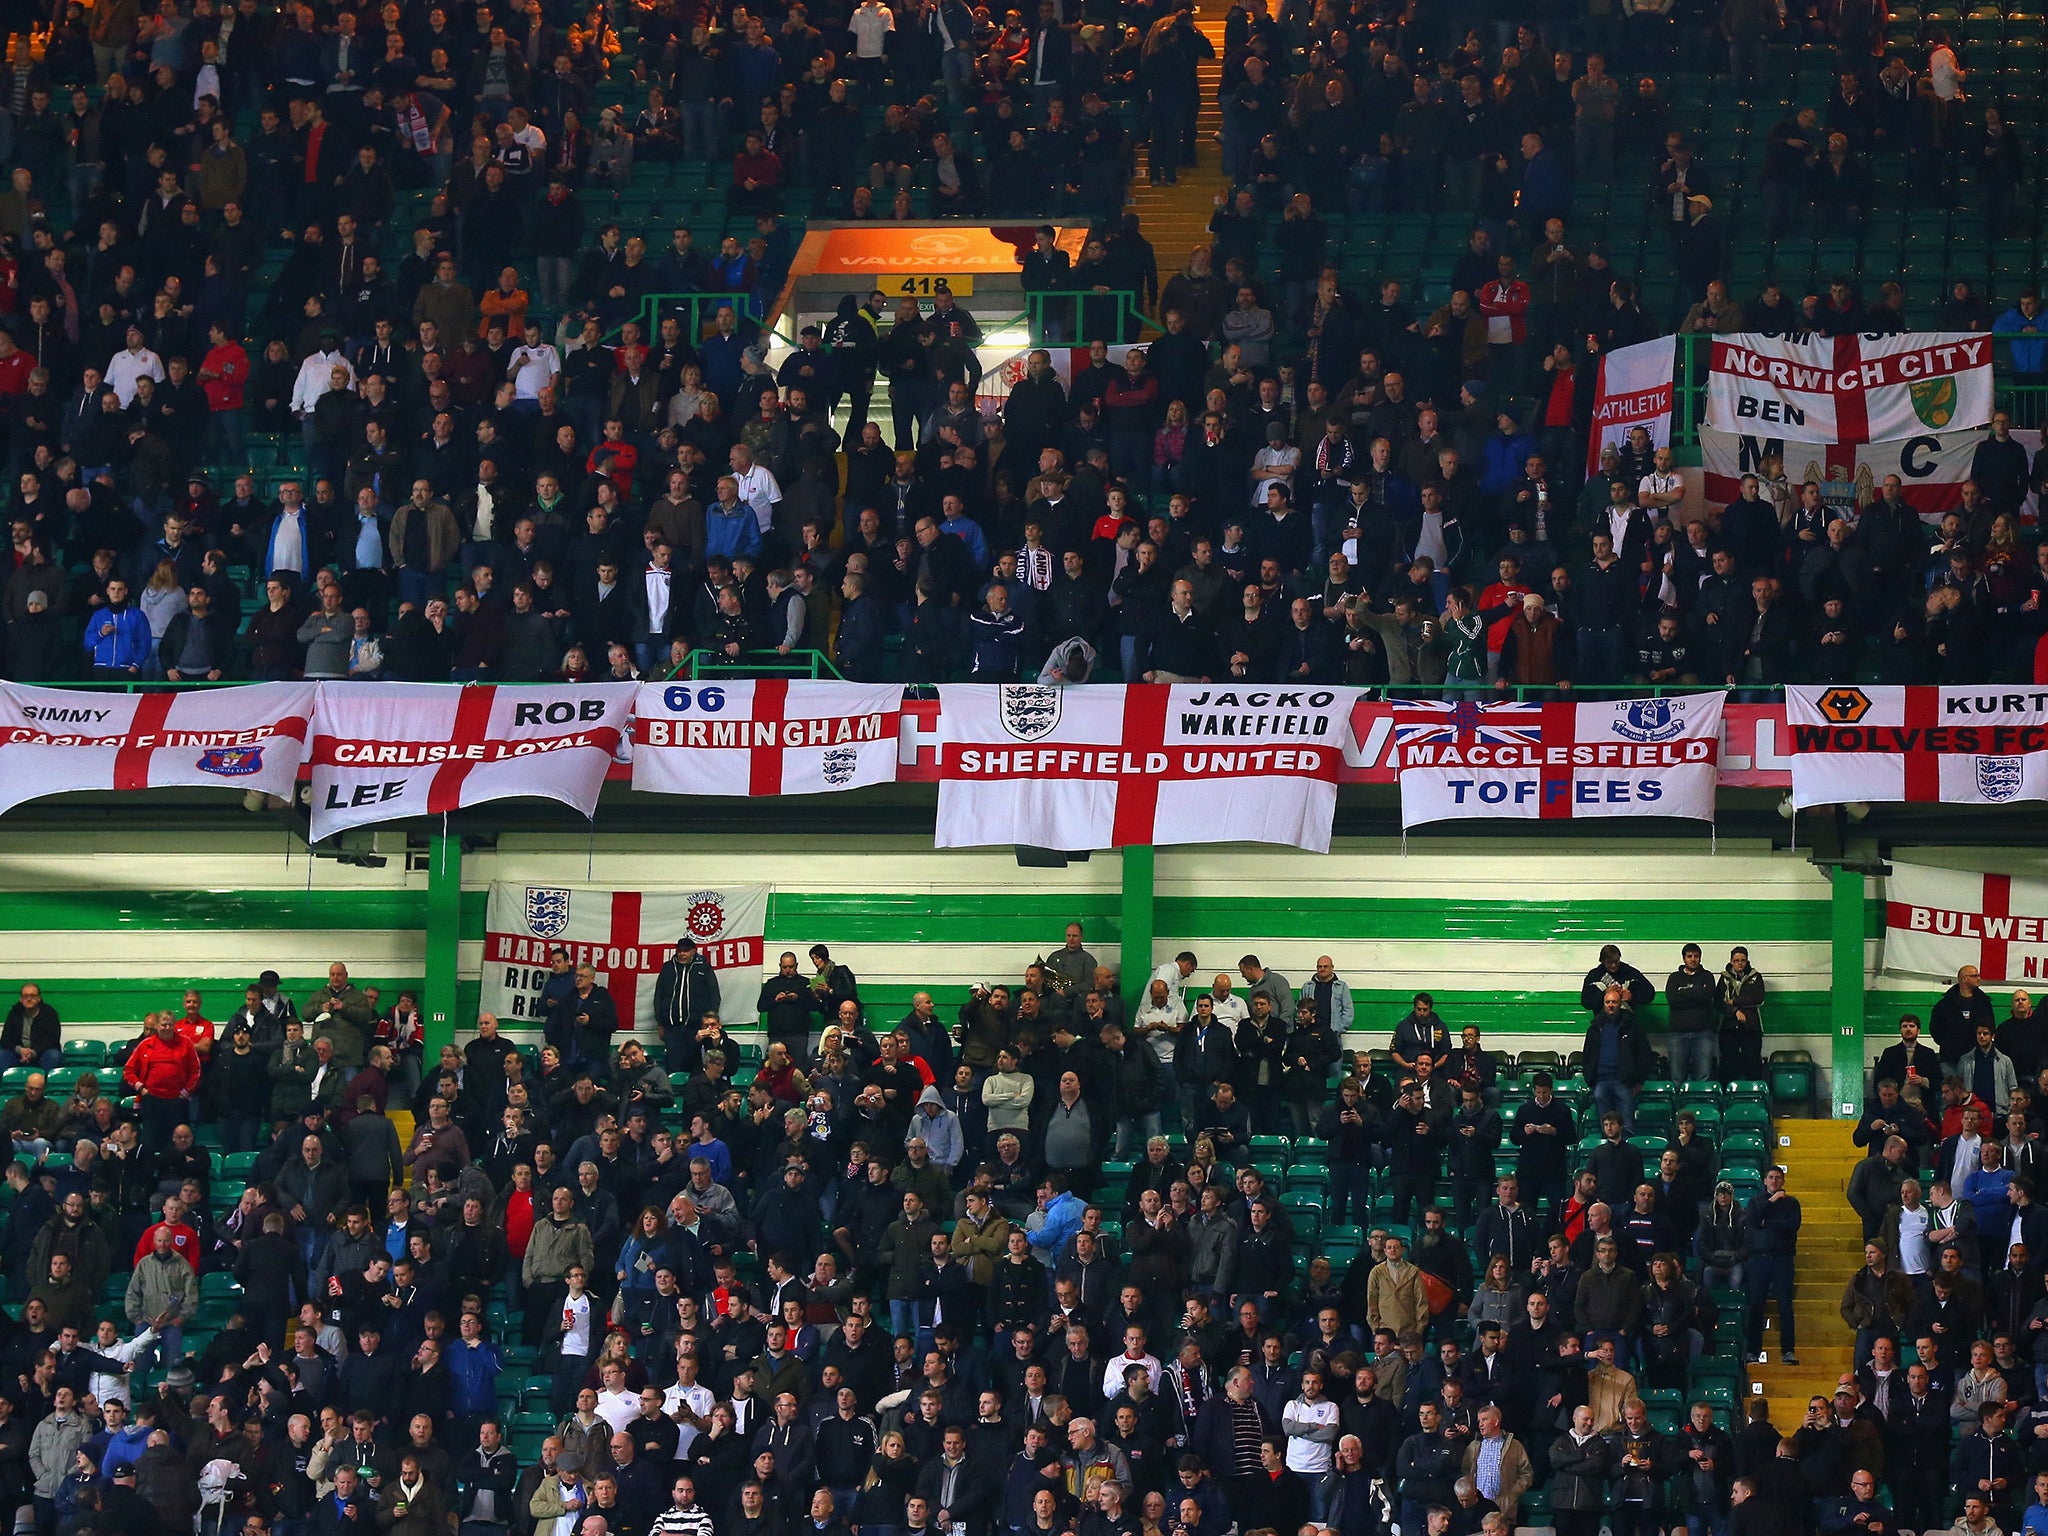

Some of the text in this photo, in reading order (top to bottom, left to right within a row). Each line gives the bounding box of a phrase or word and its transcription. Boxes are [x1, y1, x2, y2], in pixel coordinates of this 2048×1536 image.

[901, 277, 948, 294] 418
[1724, 341, 1984, 391] NORWICH CITY
[1737, 396, 1805, 426] BEN
[664, 685, 726, 712] 66
[1190, 691, 1335, 708] JACKO
[1615, 702, 1686, 713] 18 78
[1946, 693, 2048, 714] KURT
[22, 706, 111, 722] SIMMY
[515, 700, 605, 726] ROB
[1181, 713, 1329, 736] WAKEFIELD
[648, 715, 881, 747] BIRMINGHAM
[1795, 727, 2047, 753] WOLVES FC
[334, 734, 593, 765] CARLISLE LOYAL
[1406, 742, 1709, 766] MACCLESFIELD
[960, 750, 1321, 775] SHEFFIELD UNITED
[326, 780, 408, 810] LEE
[1447, 780, 1663, 804] TOFFEES
[663, 941, 751, 967] UTED
[505, 967, 545, 992] RIC
[512, 995, 542, 1017] RH
